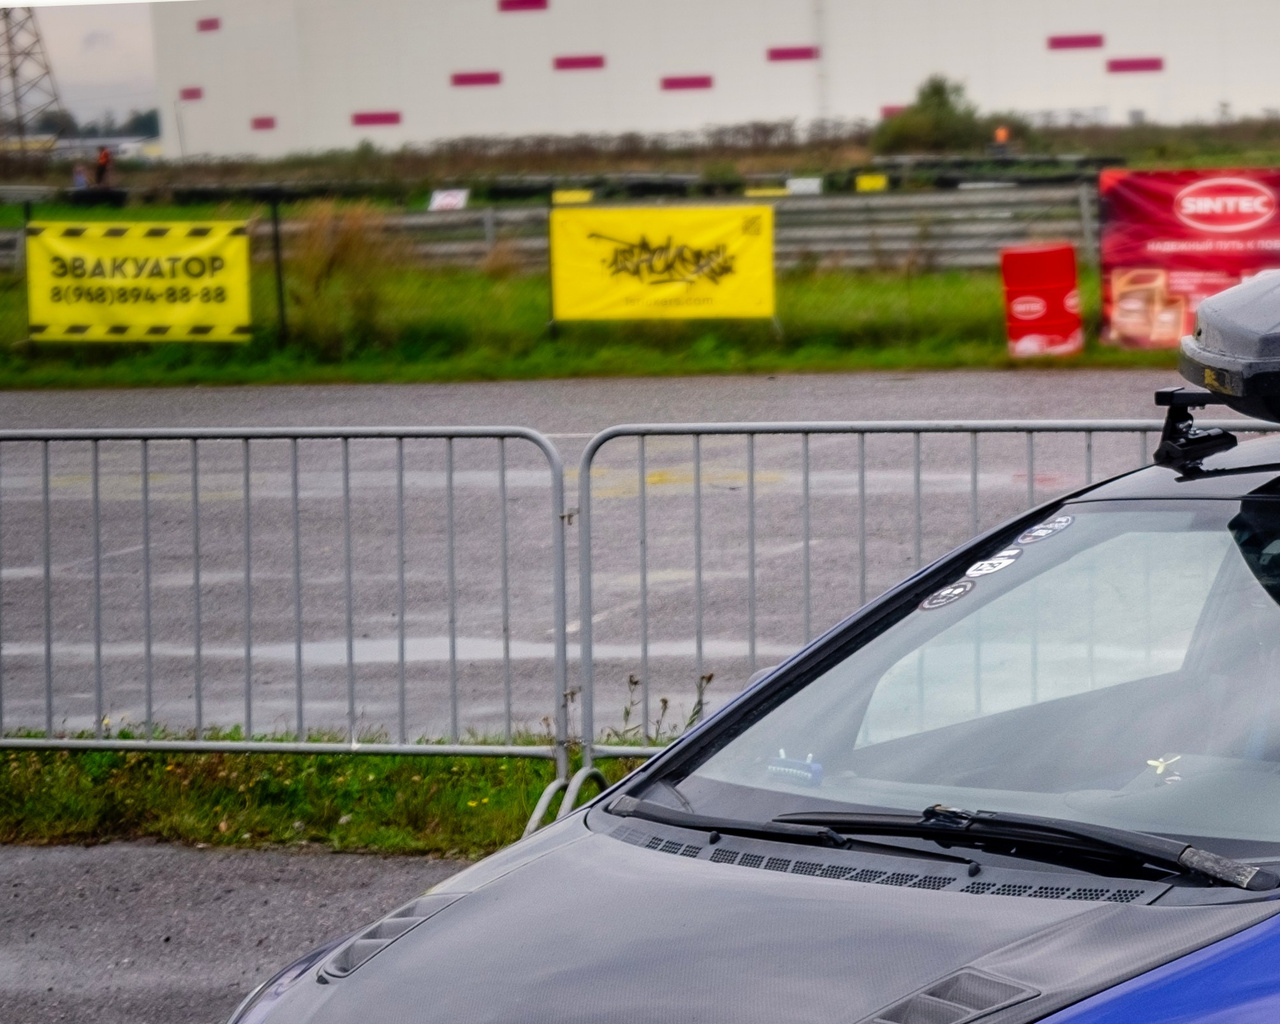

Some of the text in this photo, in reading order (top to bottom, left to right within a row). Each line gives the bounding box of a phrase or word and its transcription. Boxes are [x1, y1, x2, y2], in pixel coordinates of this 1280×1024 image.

[1181, 196, 1269, 214] SINTEC
[1146, 240, 1213, 251] НАДЕЖНЫЙ
[1216, 240, 1244, 250] ПУТЬ
[1247, 240, 1255, 249] К
[51, 256, 224, 279] ЭВАКУАТОР
